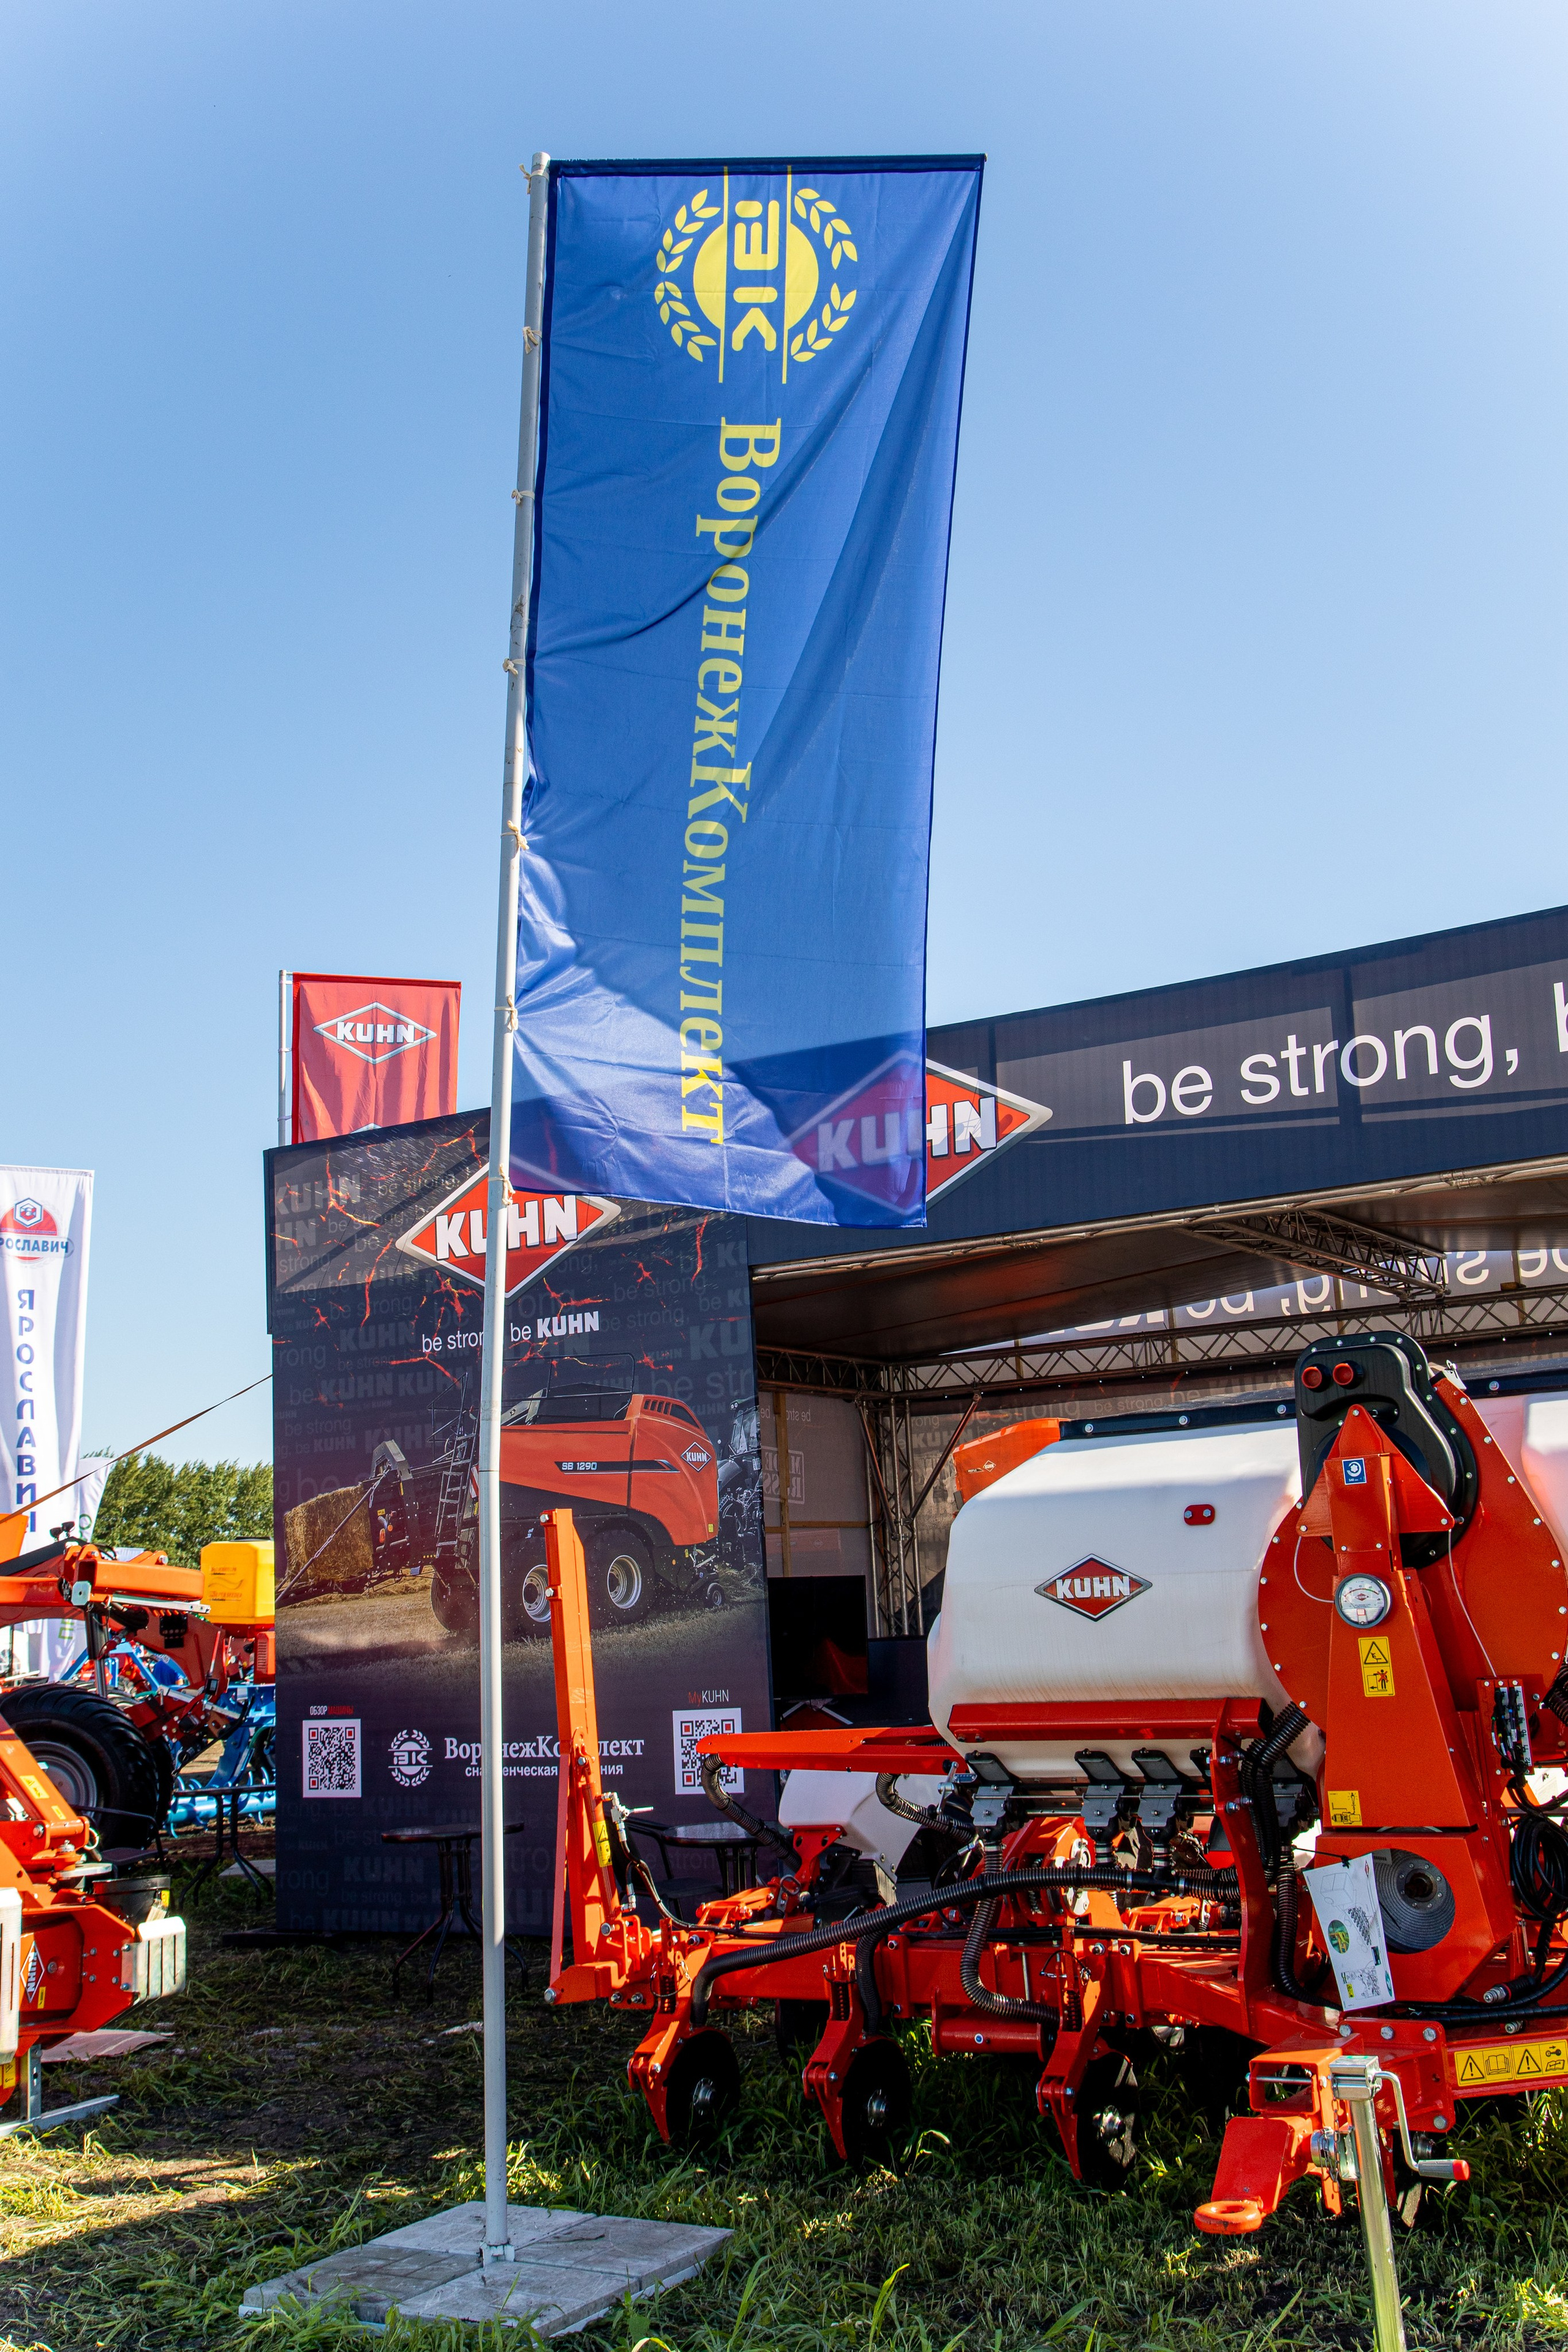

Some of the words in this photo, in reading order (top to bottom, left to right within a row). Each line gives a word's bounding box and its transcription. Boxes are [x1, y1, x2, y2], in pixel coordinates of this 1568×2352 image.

[679, 417, 782, 1145] ВоронежКомплект
[336, 1021, 415, 1044] KUHN
[1123, 1060, 1213, 1125] be
[1240, 1014, 1520, 1106] strong,
[816, 1097, 998, 1174] KUHN
[276, 1218, 317, 1251] HN
[435, 1194, 579, 1262] KUHN
[0, 1237, 69, 1253] РОСЛАВИЧ
[340, 1321, 417, 1353] KUHN
[422, 1333, 442, 1353] be
[447, 1330, 484, 1350] stro
[510, 1323, 532, 1342] be
[537, 1311, 600, 1338] KUHN
[688, 1321, 750, 1361] KU
[273, 1344, 326, 1370] trong
[290, 1385, 314, 1406] be
[320, 1371, 393, 1401] KUHN
[706, 1363, 752, 1400] str
[284, 1422, 303, 1437] be
[305, 1417, 352, 1436] strong
[313, 1435, 356, 1453] KUHN
[685, 1452, 707, 1463] KUHN
[576, 1461, 597, 1470] 1290
[1055, 1575, 1131, 1599] KUHN
[310, 1705, 328, 1716] ОБЗОР
[278, 1869, 330, 1896] rong
[343, 1856, 424, 1883] KUHN
[26, 1951, 38, 1992] KUHN
